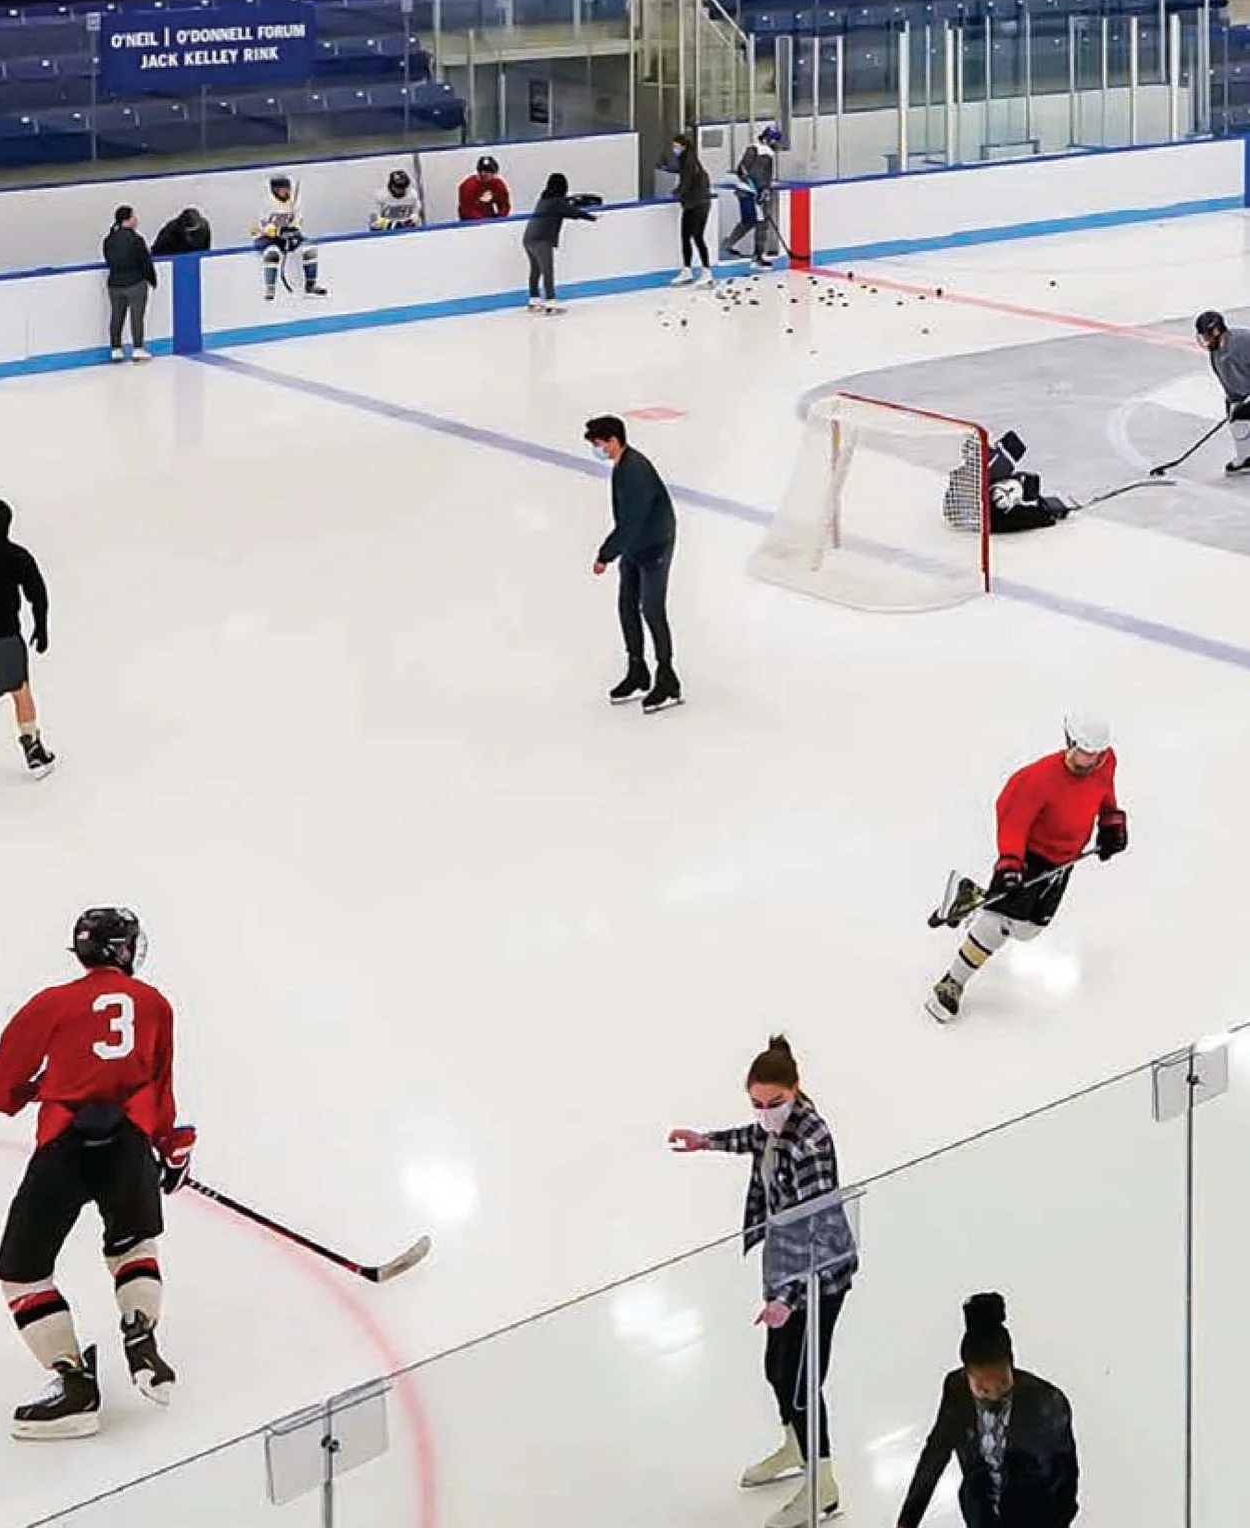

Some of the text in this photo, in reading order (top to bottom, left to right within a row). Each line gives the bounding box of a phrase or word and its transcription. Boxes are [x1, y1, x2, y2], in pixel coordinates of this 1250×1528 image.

[111, 31, 159, 48] O'NEIL
[176, 26, 253, 45] O'DONNELL
[257, 24, 306, 40] FORUM
[140, 46, 279, 70] JACK KELLEY RINK
[92, 992, 135, 1060] 3
